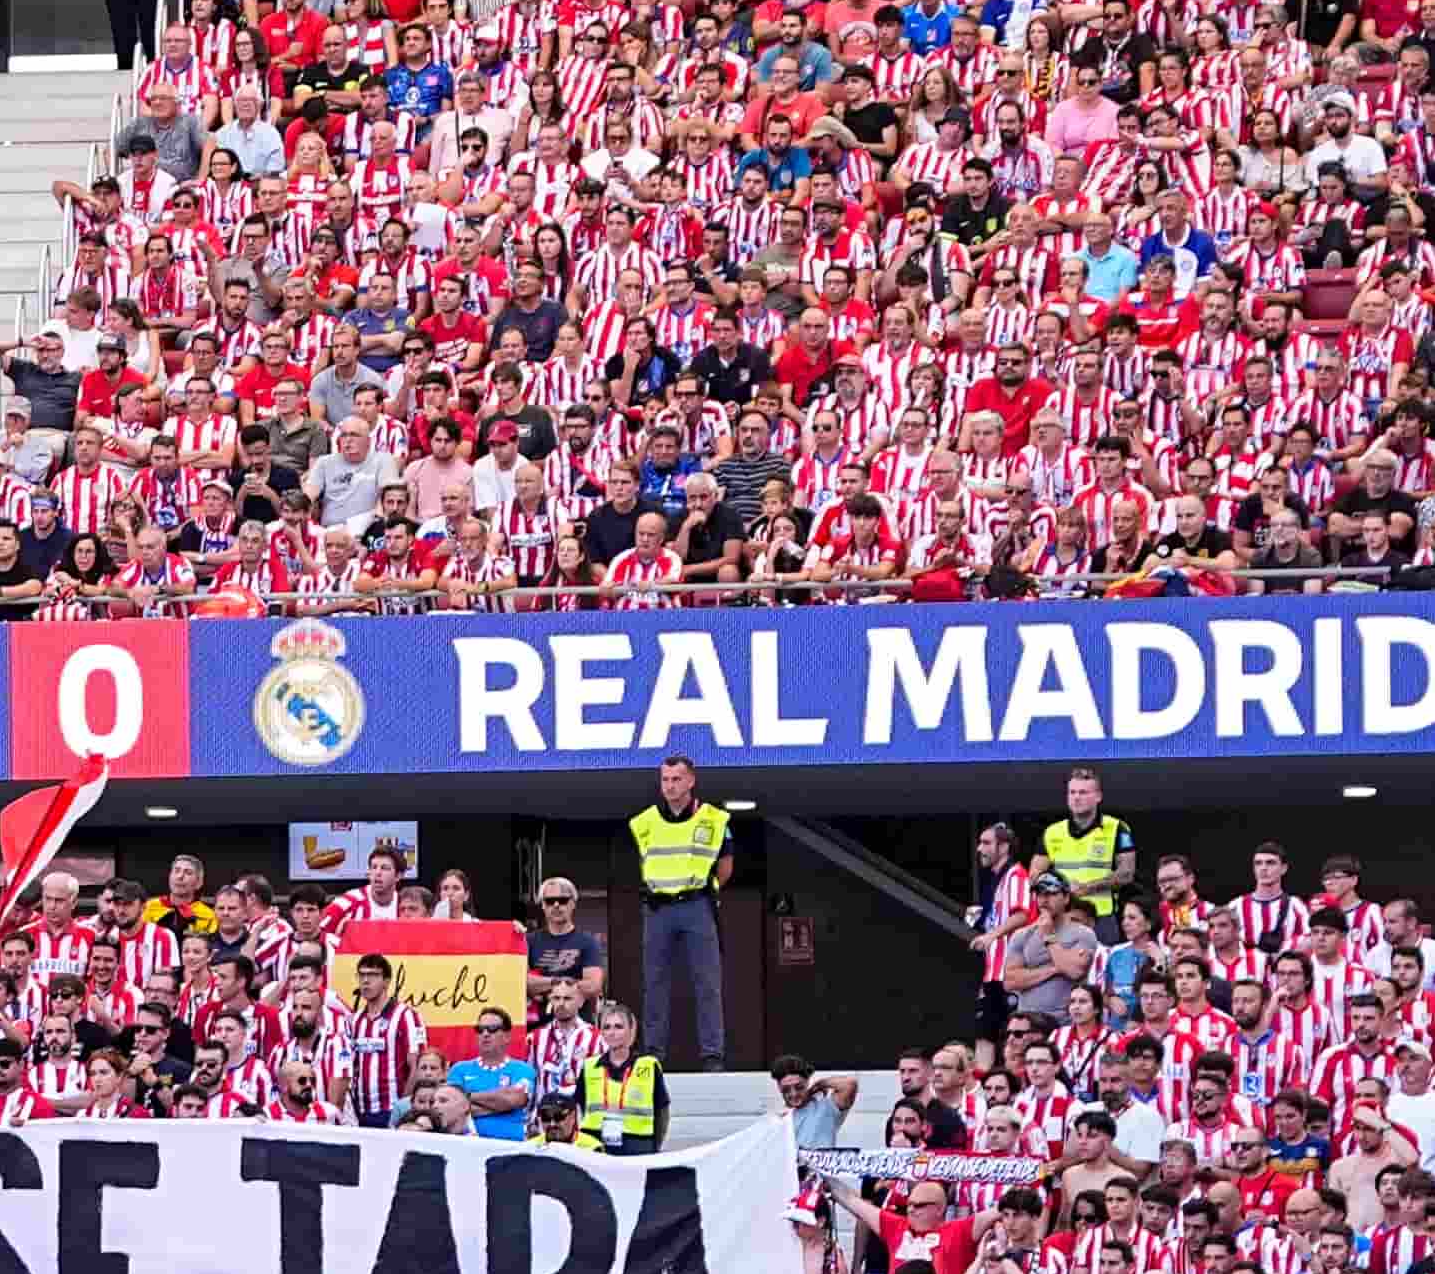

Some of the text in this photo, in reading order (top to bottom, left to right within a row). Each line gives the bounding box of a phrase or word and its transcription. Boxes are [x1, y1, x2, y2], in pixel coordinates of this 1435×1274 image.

[58, 643, 144, 760] 0
[452, 619, 1435, 752] REAL MADRID
